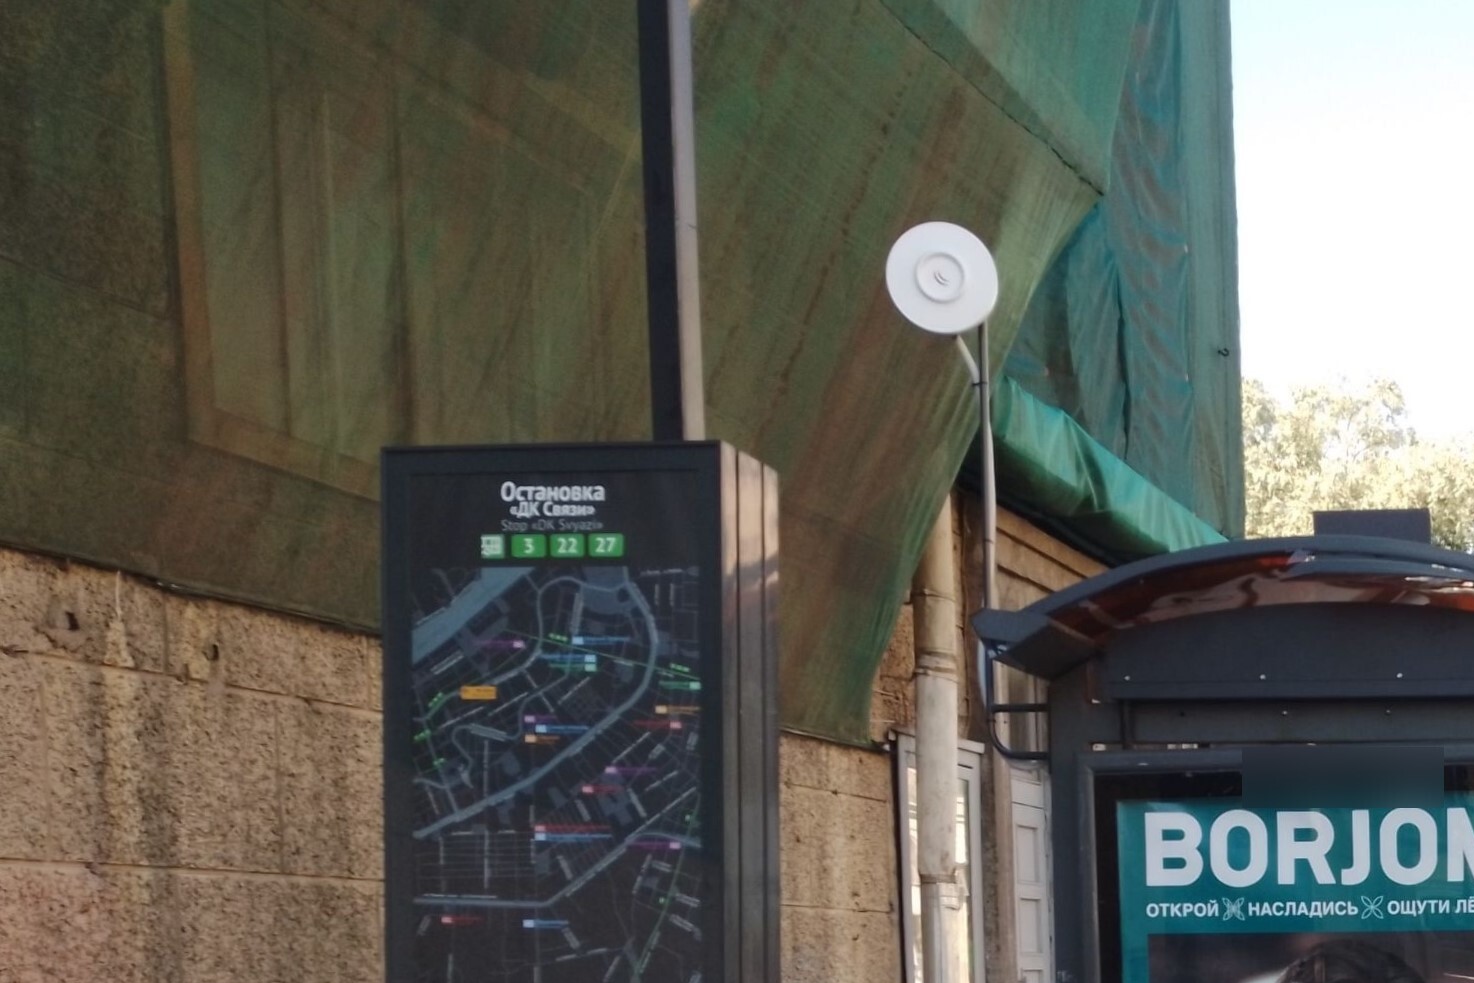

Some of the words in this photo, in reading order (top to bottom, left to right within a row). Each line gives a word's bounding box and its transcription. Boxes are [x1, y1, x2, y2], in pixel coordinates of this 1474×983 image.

[500, 481, 606, 502] Остановка
[509, 501, 540, 518] «ДК
[542, 501, 596, 517] Связи»
[501, 519, 528, 531] Stop
[523, 537, 535, 554] 3
[557, 537, 578, 554] 22
[595, 536, 617, 553] 27
[1145, 899, 1219, 919] ОТКРОЙ
[1248, 900, 1359, 918] НАСЛАДИСЬ
[1387, 899, 1450, 917] ОЩУТИ
